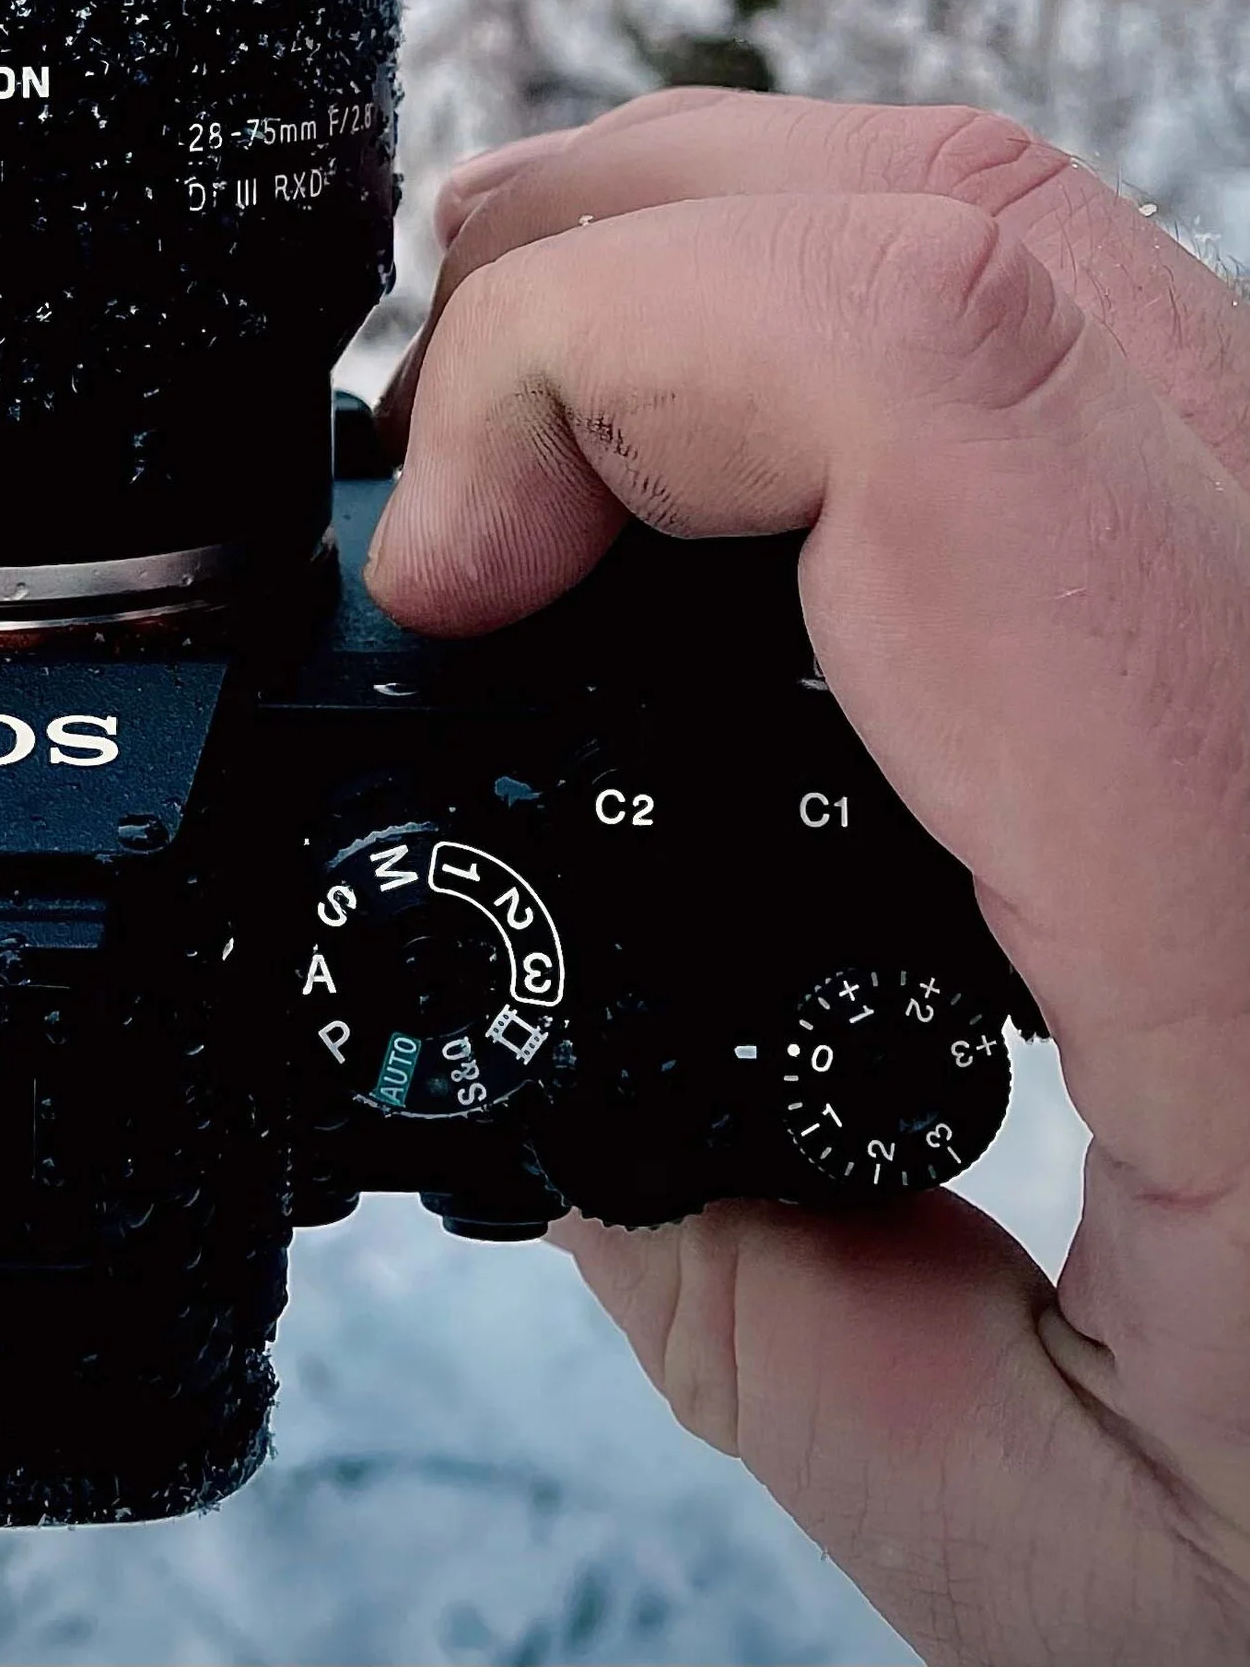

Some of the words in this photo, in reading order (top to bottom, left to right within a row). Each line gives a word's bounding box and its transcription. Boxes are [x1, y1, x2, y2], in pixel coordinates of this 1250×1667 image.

[188, 117, 317, 153] 28-75mm
[237, 177, 258, 209] III
[274, 169, 323, 202] RXD
[595, 789, 655, 826] C2
[799, 792, 849, 828] C1
[369, 844, 419, 892] M
[317, 885, 357, 927] S
[442, 863, 481, 882] 1
[494, 886, 534, 930] 2
[523, 952, 553, 993] 3
[302, 953, 337, 995] A
[318, 1020, 351, 1064] P
[811, 1044, 834, 1073] 0
[379, 1036, 420, 1105] AUTO
